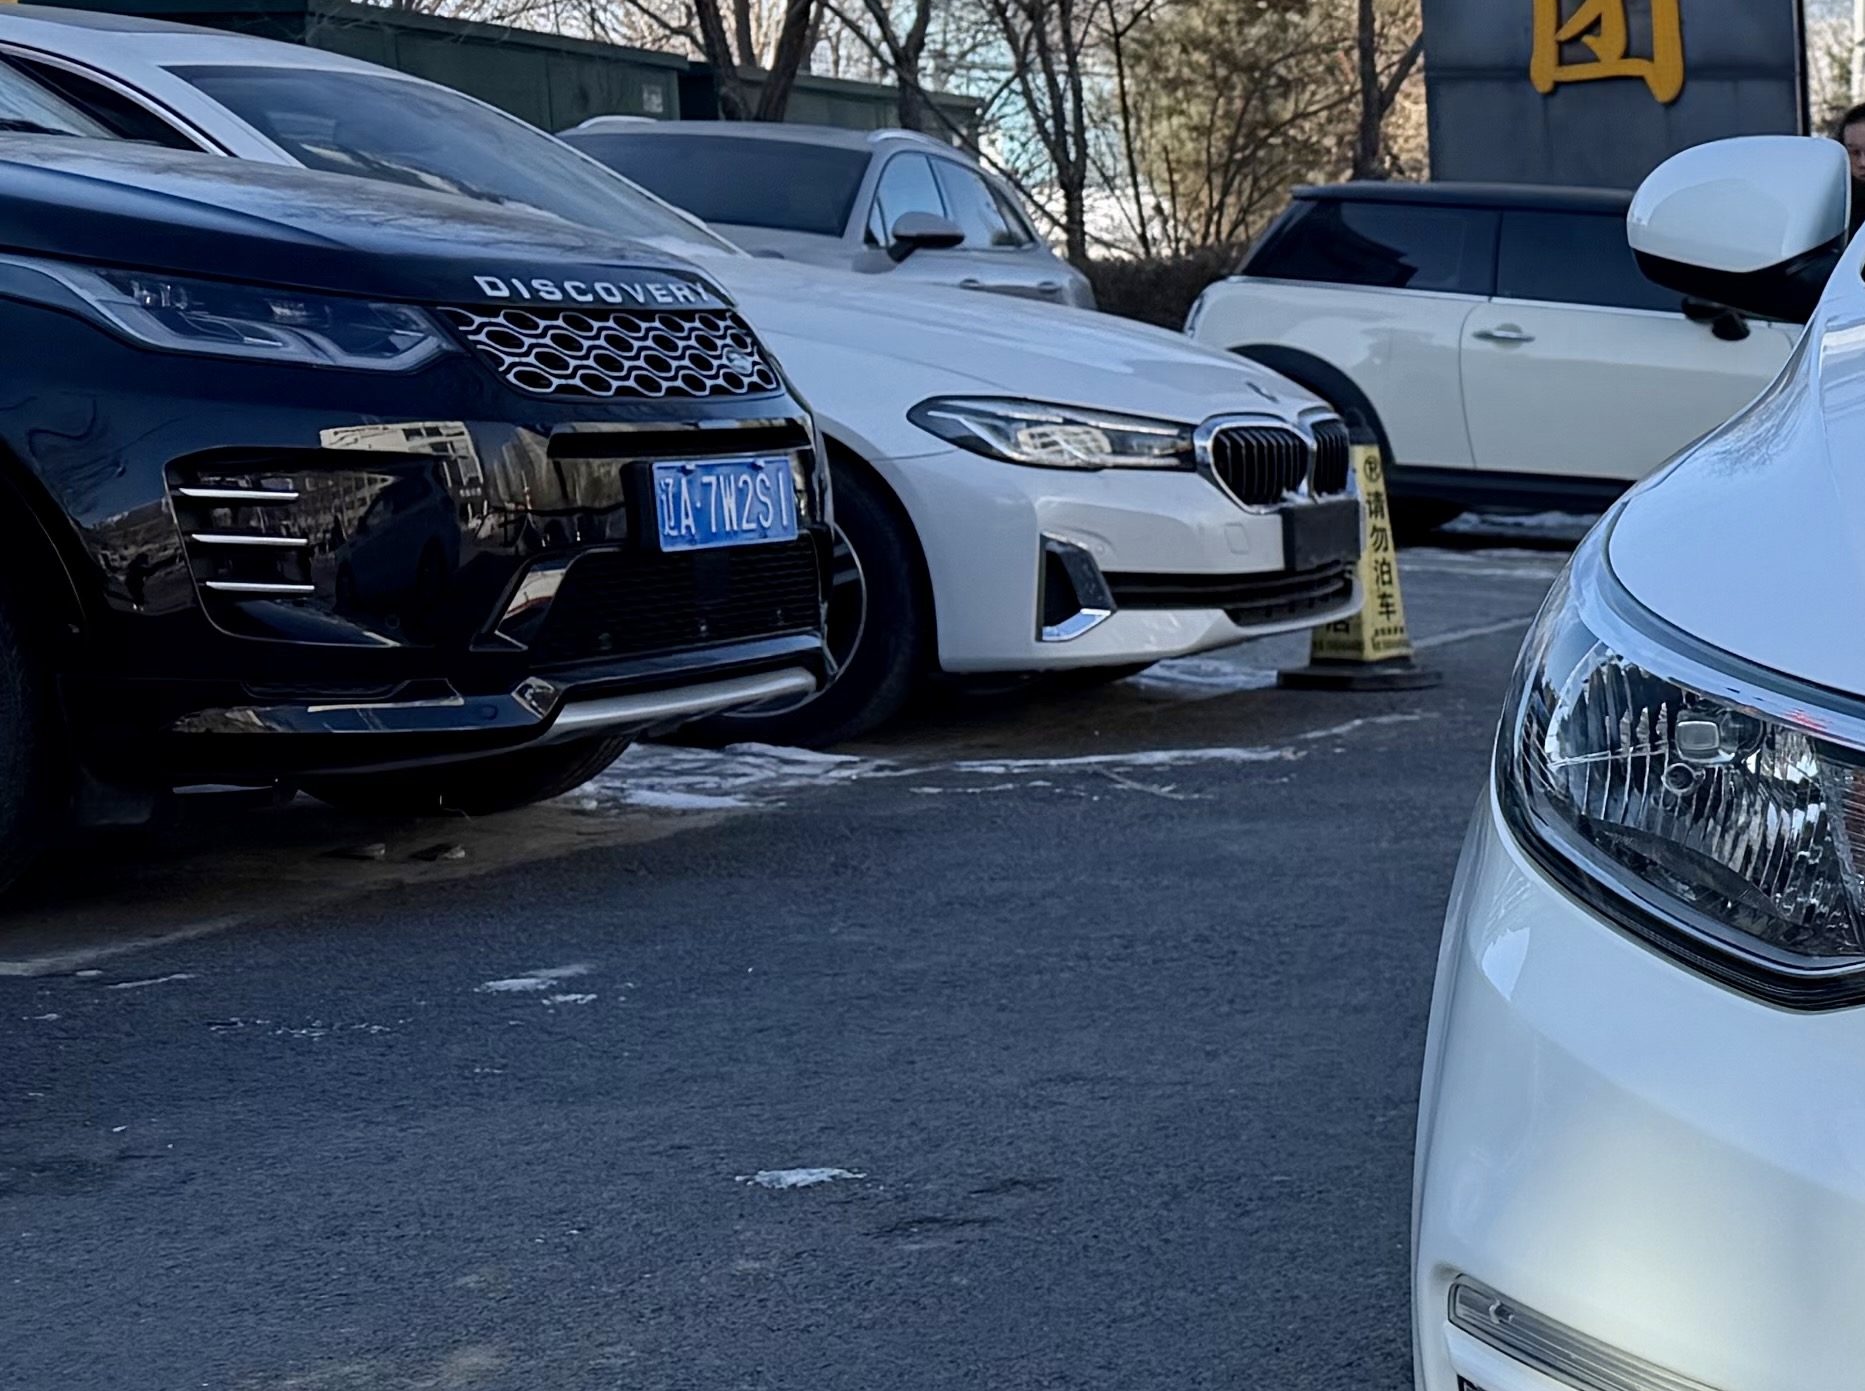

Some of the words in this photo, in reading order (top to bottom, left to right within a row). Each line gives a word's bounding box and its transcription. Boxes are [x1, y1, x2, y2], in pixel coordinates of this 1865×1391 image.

[473, 275, 709, 304] DISCOVERY
[1366, 491, 1397, 621] 请勿泊车
